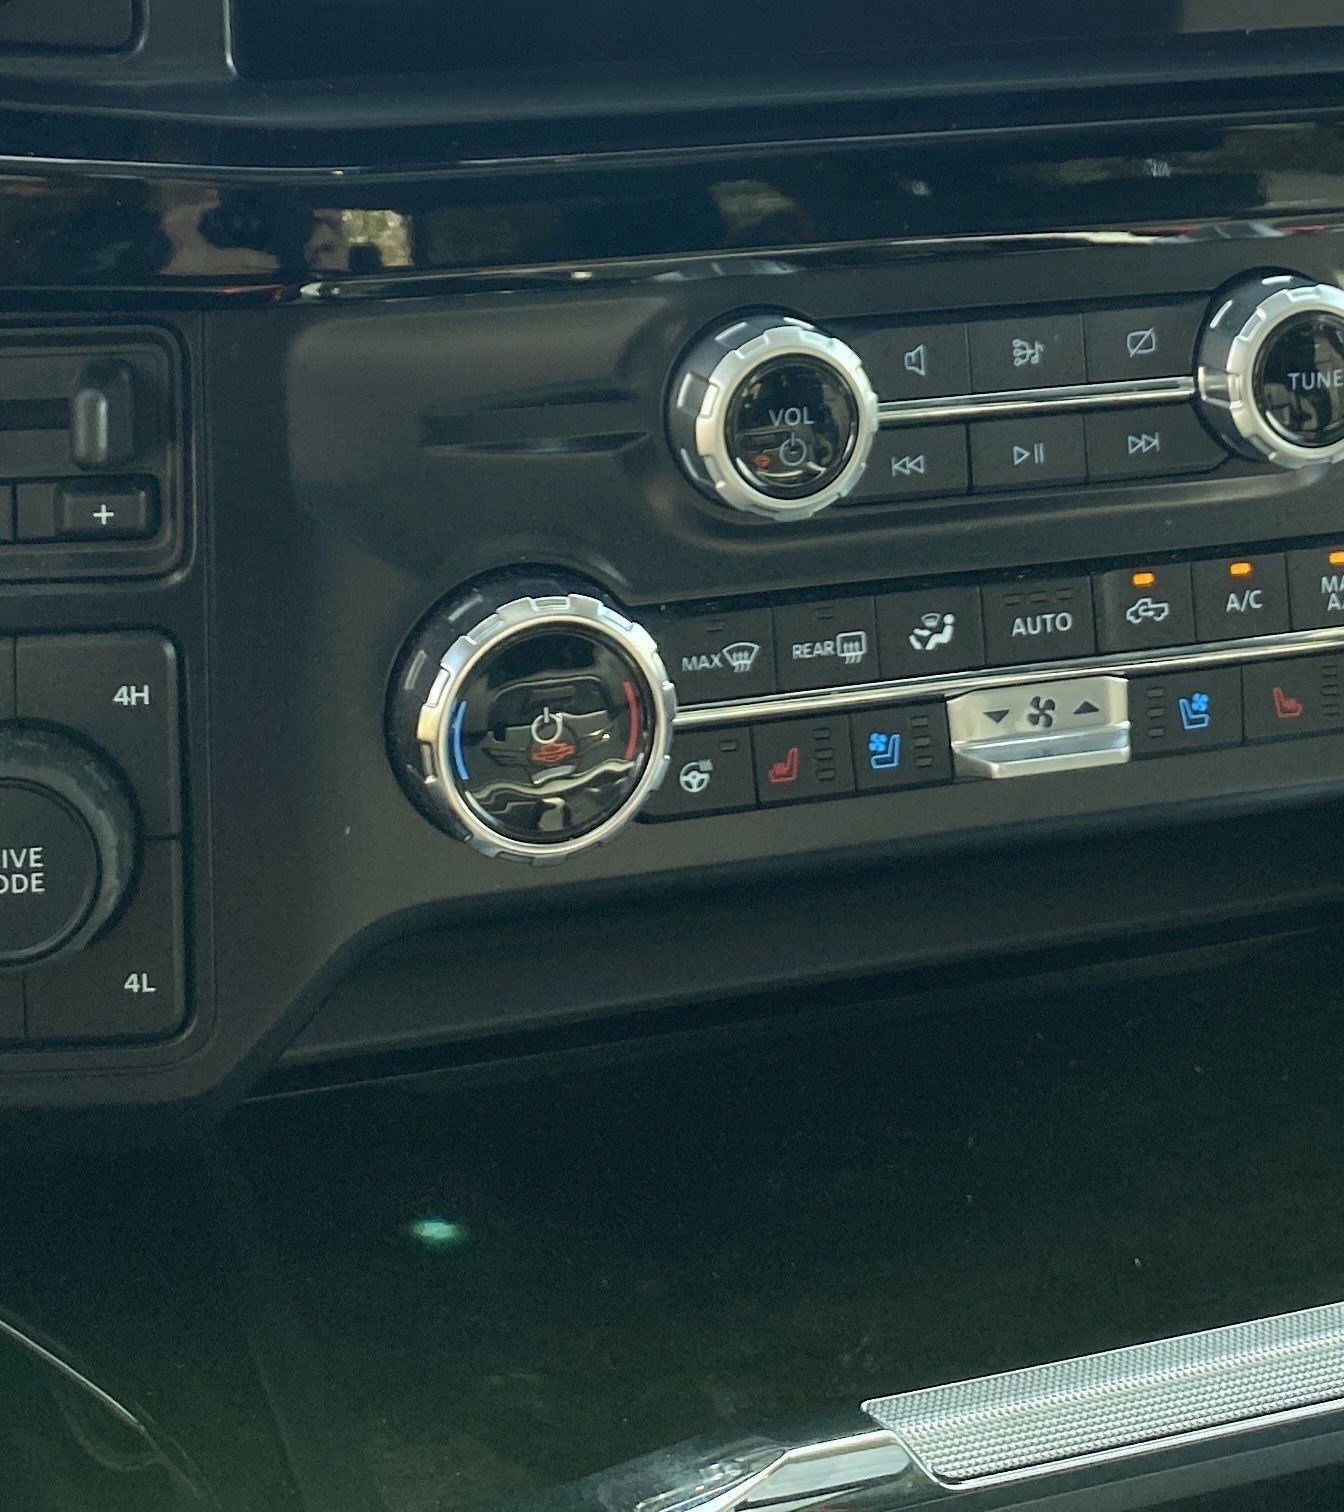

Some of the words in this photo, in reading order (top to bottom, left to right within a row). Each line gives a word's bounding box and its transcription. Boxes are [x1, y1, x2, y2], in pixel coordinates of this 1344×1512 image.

[1287, 368, 1344, 391] TUNE
[768, 406, 815, 428] VOL
[1226, 590, 1263, 612] A/C
[1011, 612, 1074, 638] AUTO
[792, 640, 836, 661] REAR
[681, 654, 722, 673] MAX
[112, 684, 150, 706] 4H
[124, 973, 156, 993] 4L
